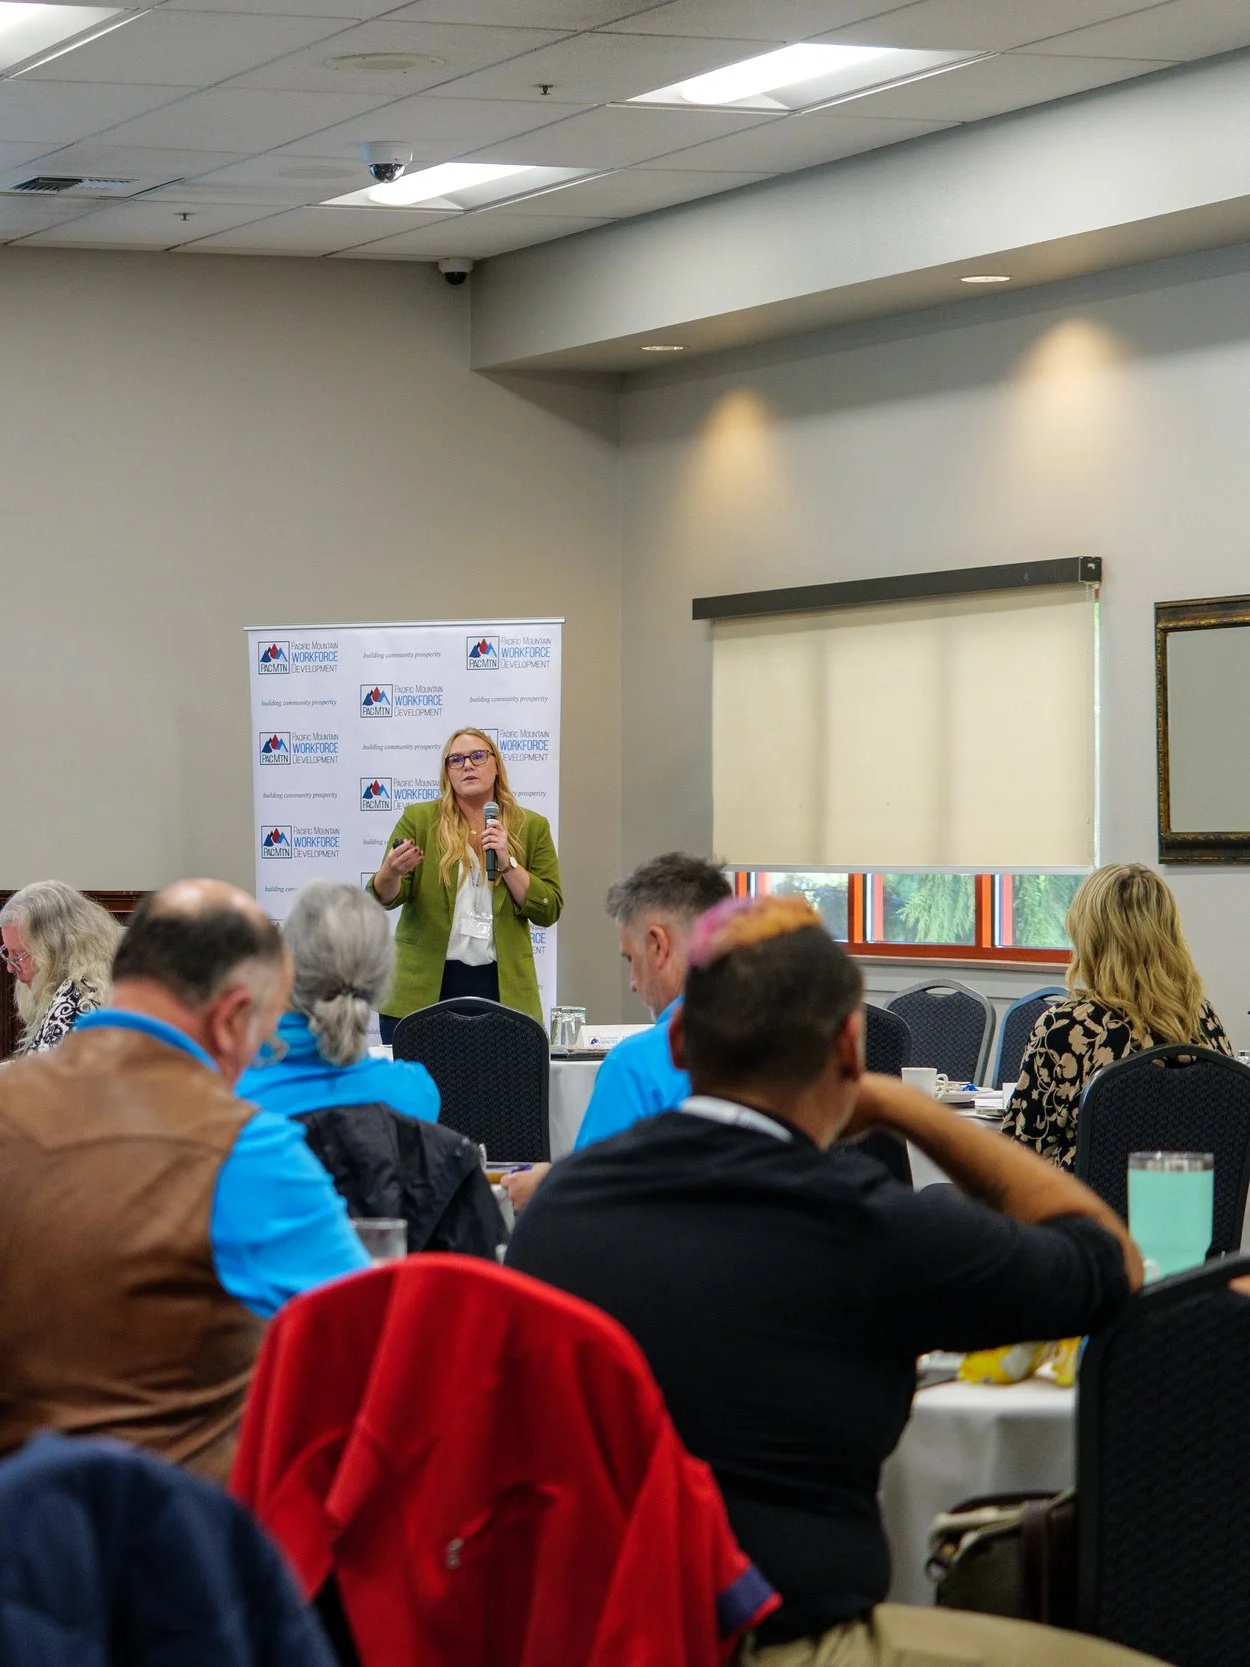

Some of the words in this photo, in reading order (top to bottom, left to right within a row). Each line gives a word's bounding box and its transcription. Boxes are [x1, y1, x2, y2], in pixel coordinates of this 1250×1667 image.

[501, 637, 521, 645] PACIFIC
[523, 636, 551, 645] MOUNTAIN
[291, 642, 310, 650] PACIFIC
[312, 641, 338, 649] MOUNTAIN
[292, 651, 338, 662] WORKFORCE
[501, 647, 550, 658] WORKFORCE
[501, 659, 550, 668] DEVELOPMENT
[291, 665, 338, 673] DEVELOPMENT
[394, 685, 413, 693] PACIFIC
[415, 685, 443, 693] MOUNTAIN
[395, 695, 443, 706] WORKFORCE
[394, 707, 443, 717] DEVELOPMENT
[292, 732, 311, 740] PACIFIC
[313, 732, 338, 740] MOUNTAIN
[500, 729, 518, 738] PACIFIC
[520, 729, 549, 738] MOUNTAIN
[293, 743, 338, 753] WORKFORCE
[500, 740, 548, 751] WORKFORCE
[292, 755, 338, 764] DEVELOPMENT
[393, 778, 413, 786] PACIFIC
[415, 778, 439, 786] MOUNTA
[293, 827, 312, 835] PACIFIC
[314, 827, 340, 835] MOUNTAIN
[294, 837, 340, 847] WORKFORCE
[294, 850, 339, 858] DEVELOPMENT
